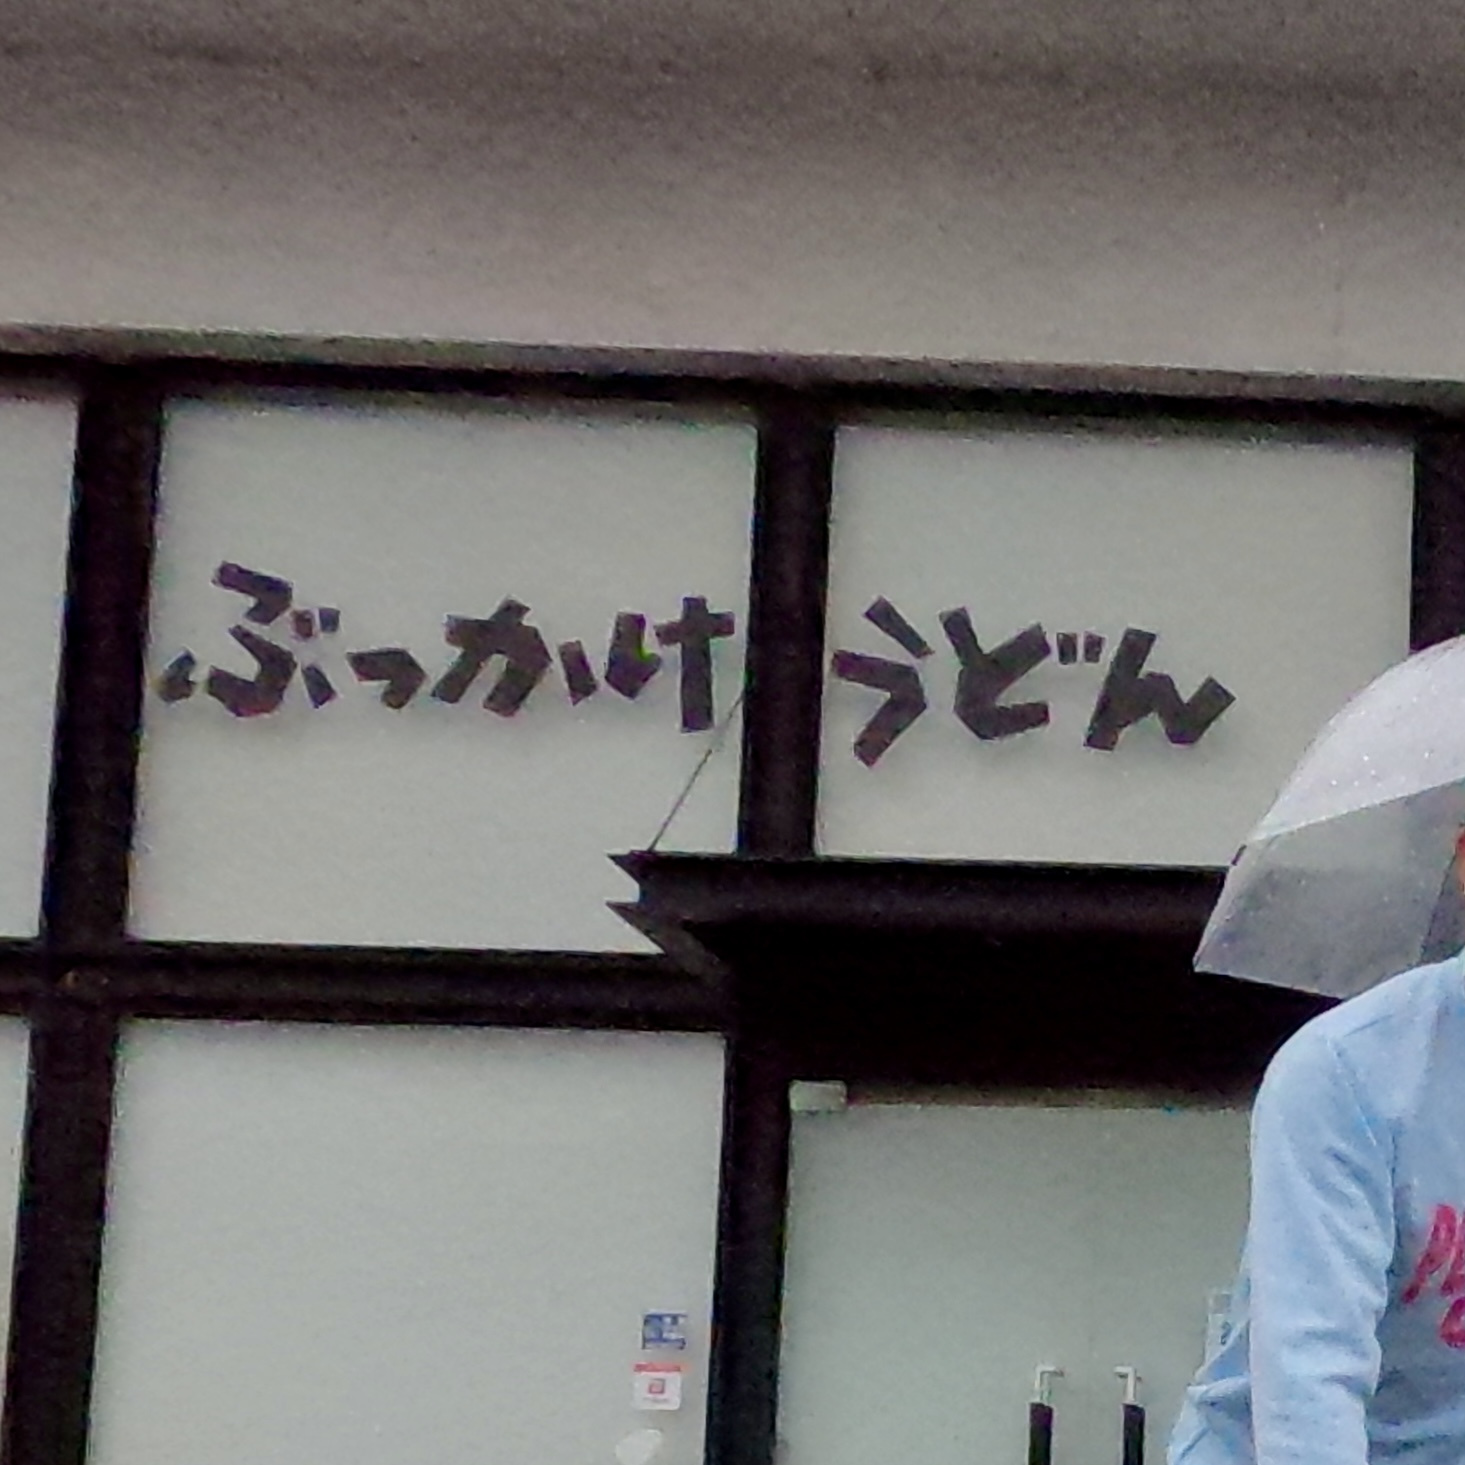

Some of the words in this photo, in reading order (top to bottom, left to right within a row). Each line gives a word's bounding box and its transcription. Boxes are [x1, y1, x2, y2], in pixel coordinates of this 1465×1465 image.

[152, 560, 735, 733] ぶっかけ
[831, 594, 1237, 768] うどん
